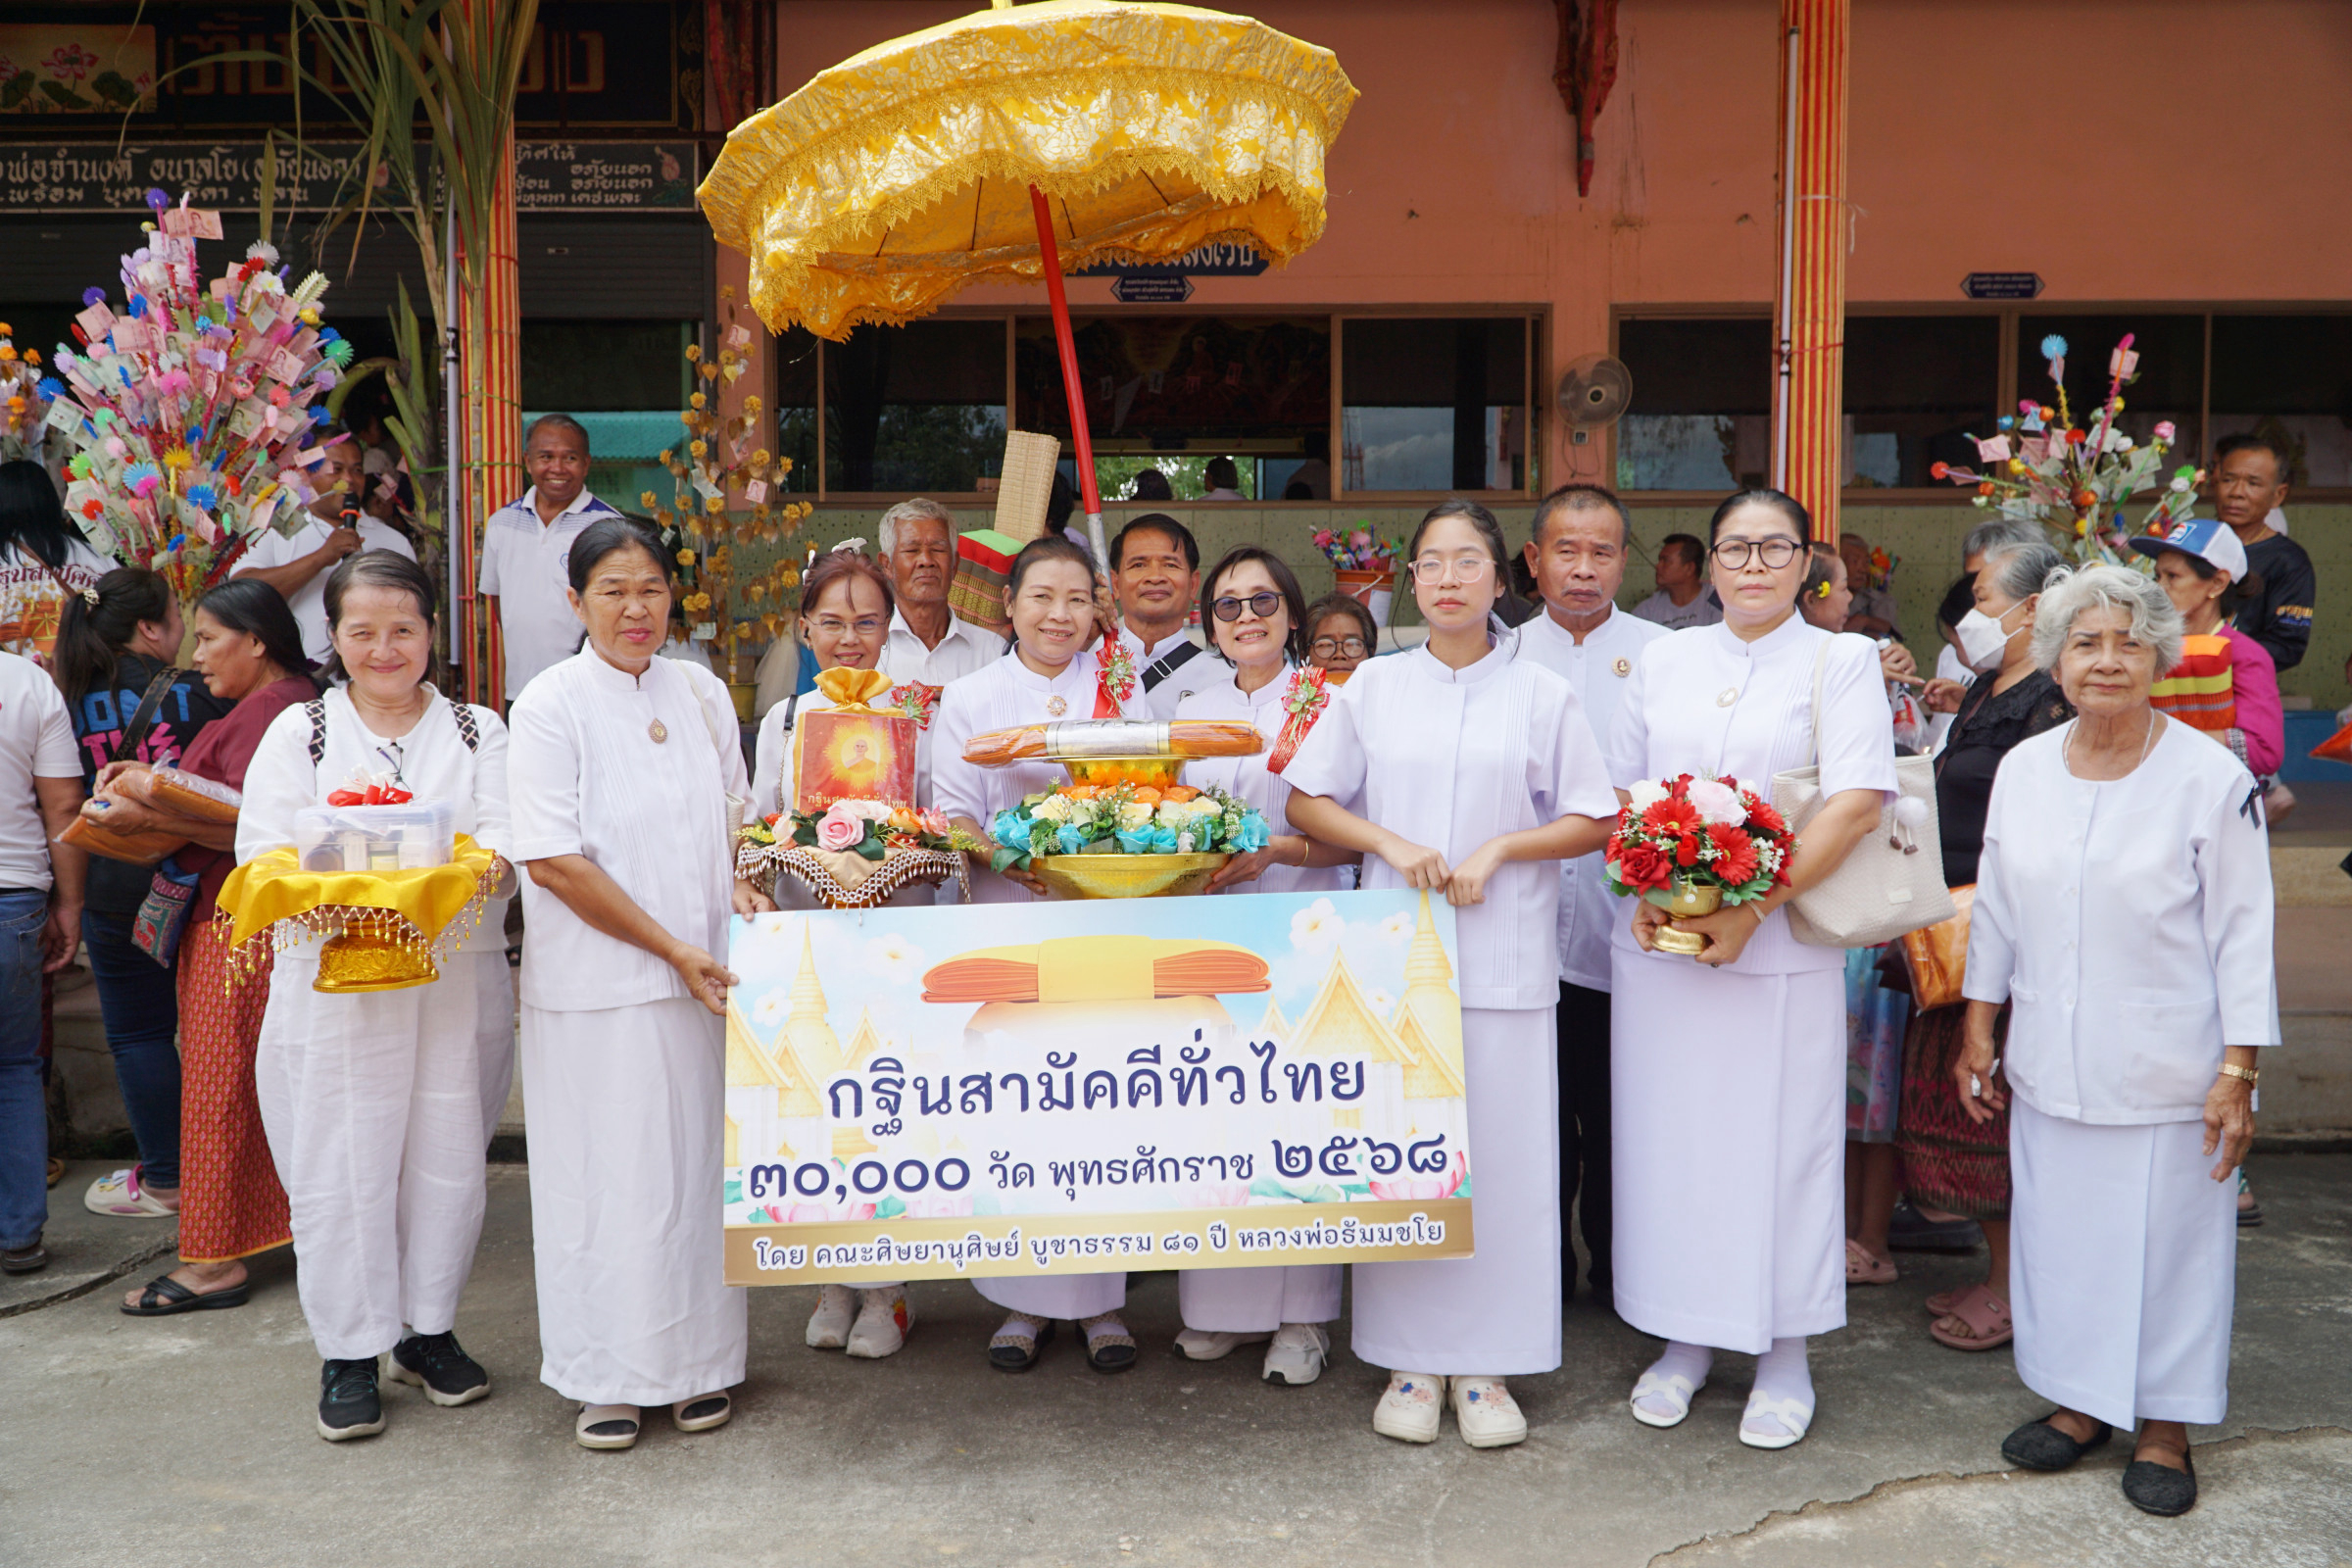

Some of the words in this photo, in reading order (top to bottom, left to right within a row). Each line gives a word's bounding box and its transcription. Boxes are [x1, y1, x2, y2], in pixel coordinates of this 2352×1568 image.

[828, 1028, 1365, 1137] กฐินสามัคคีทั่วไทย
[751, 1157, 970, 1203] ๓๐,๐๐๐
[988, 1151, 1035, 1189] วัด
[1048, 1145, 1253, 1201] พุทธศักราช
[1271, 1133, 1447, 1178] ๒๕๖๘
[756, 1240, 804, 1265] โดย
[816, 1230, 1020, 1268] คณะศิษยานุศิษย์
[1031, 1235, 1152, 1265] บูชาธรรม
[1162, 1234, 1200, 1252] ๘๑
[1211, 1223, 1227, 1249] ปี
[1239, 1216, 1444, 1249] หลวงพ่อธัมมชโย
